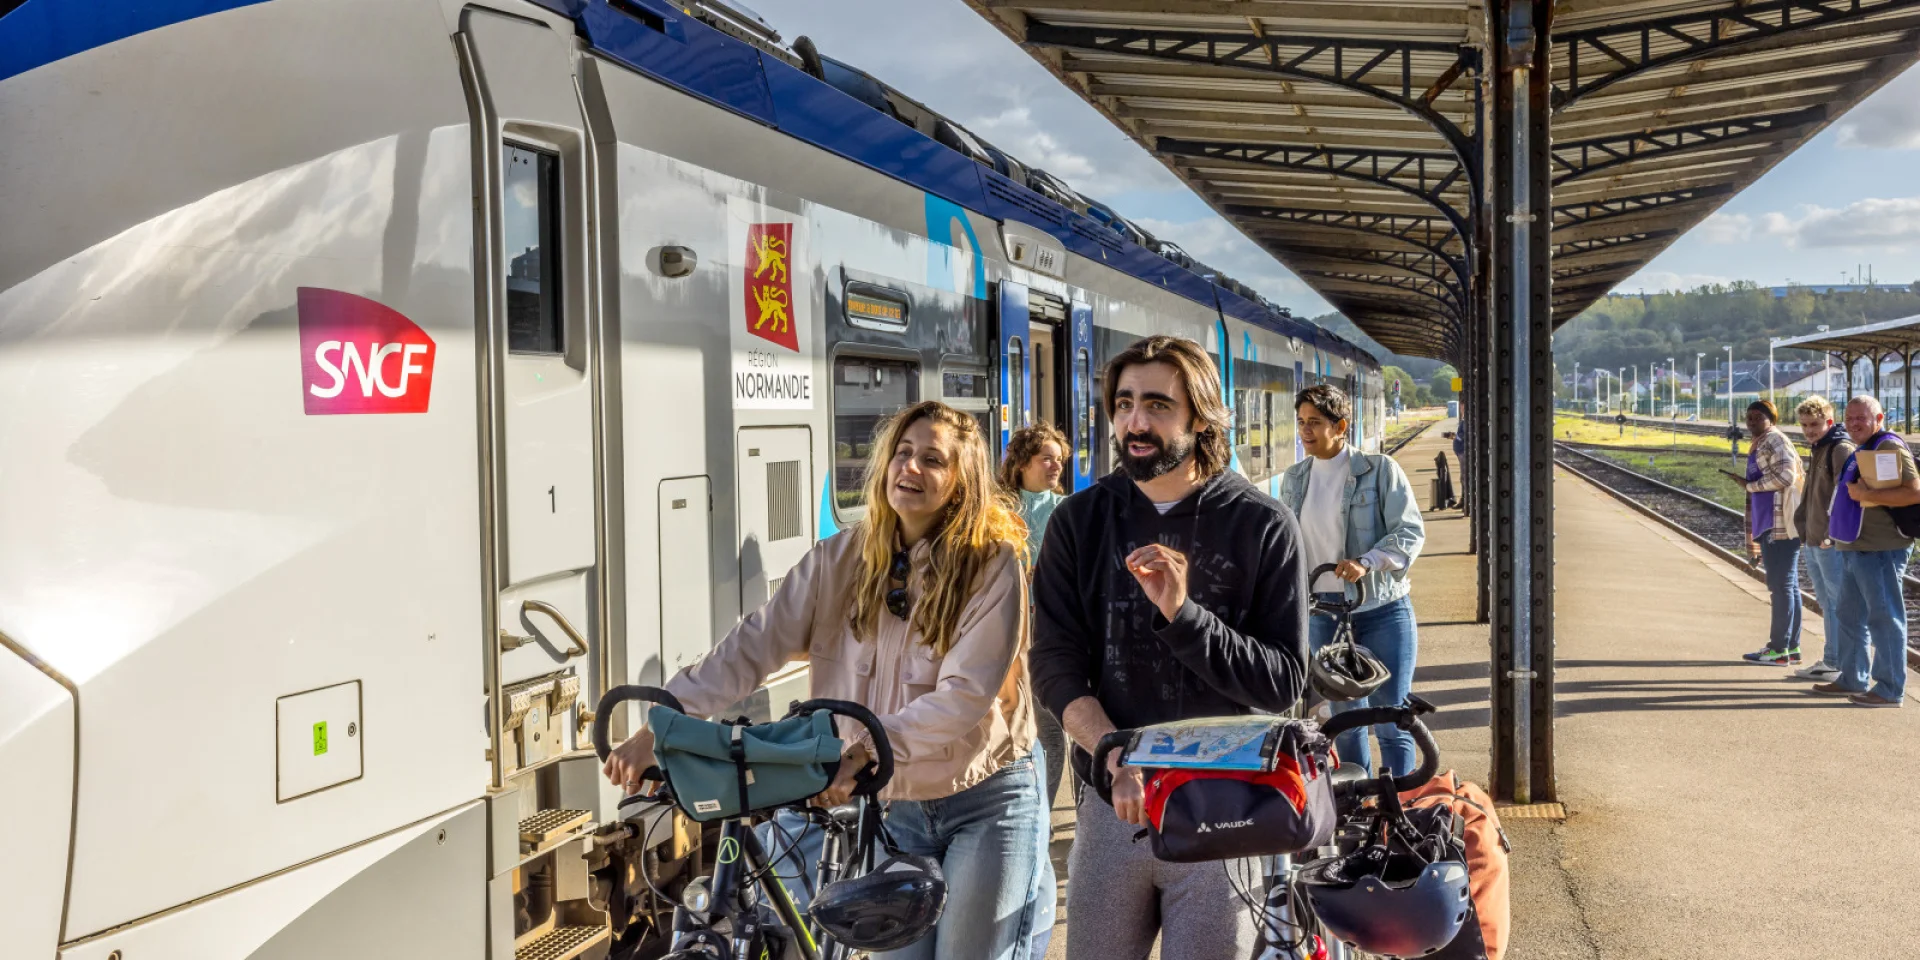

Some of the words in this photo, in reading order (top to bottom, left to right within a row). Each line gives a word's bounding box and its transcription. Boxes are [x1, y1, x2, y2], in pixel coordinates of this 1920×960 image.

[310, 340, 428, 398] SNCF
[748, 348, 778, 367] RÉGION
[736, 371, 810, 399] NORMANDIE
[547, 485, 556, 513] 1
[1214, 818, 1255, 829] VAUDE
